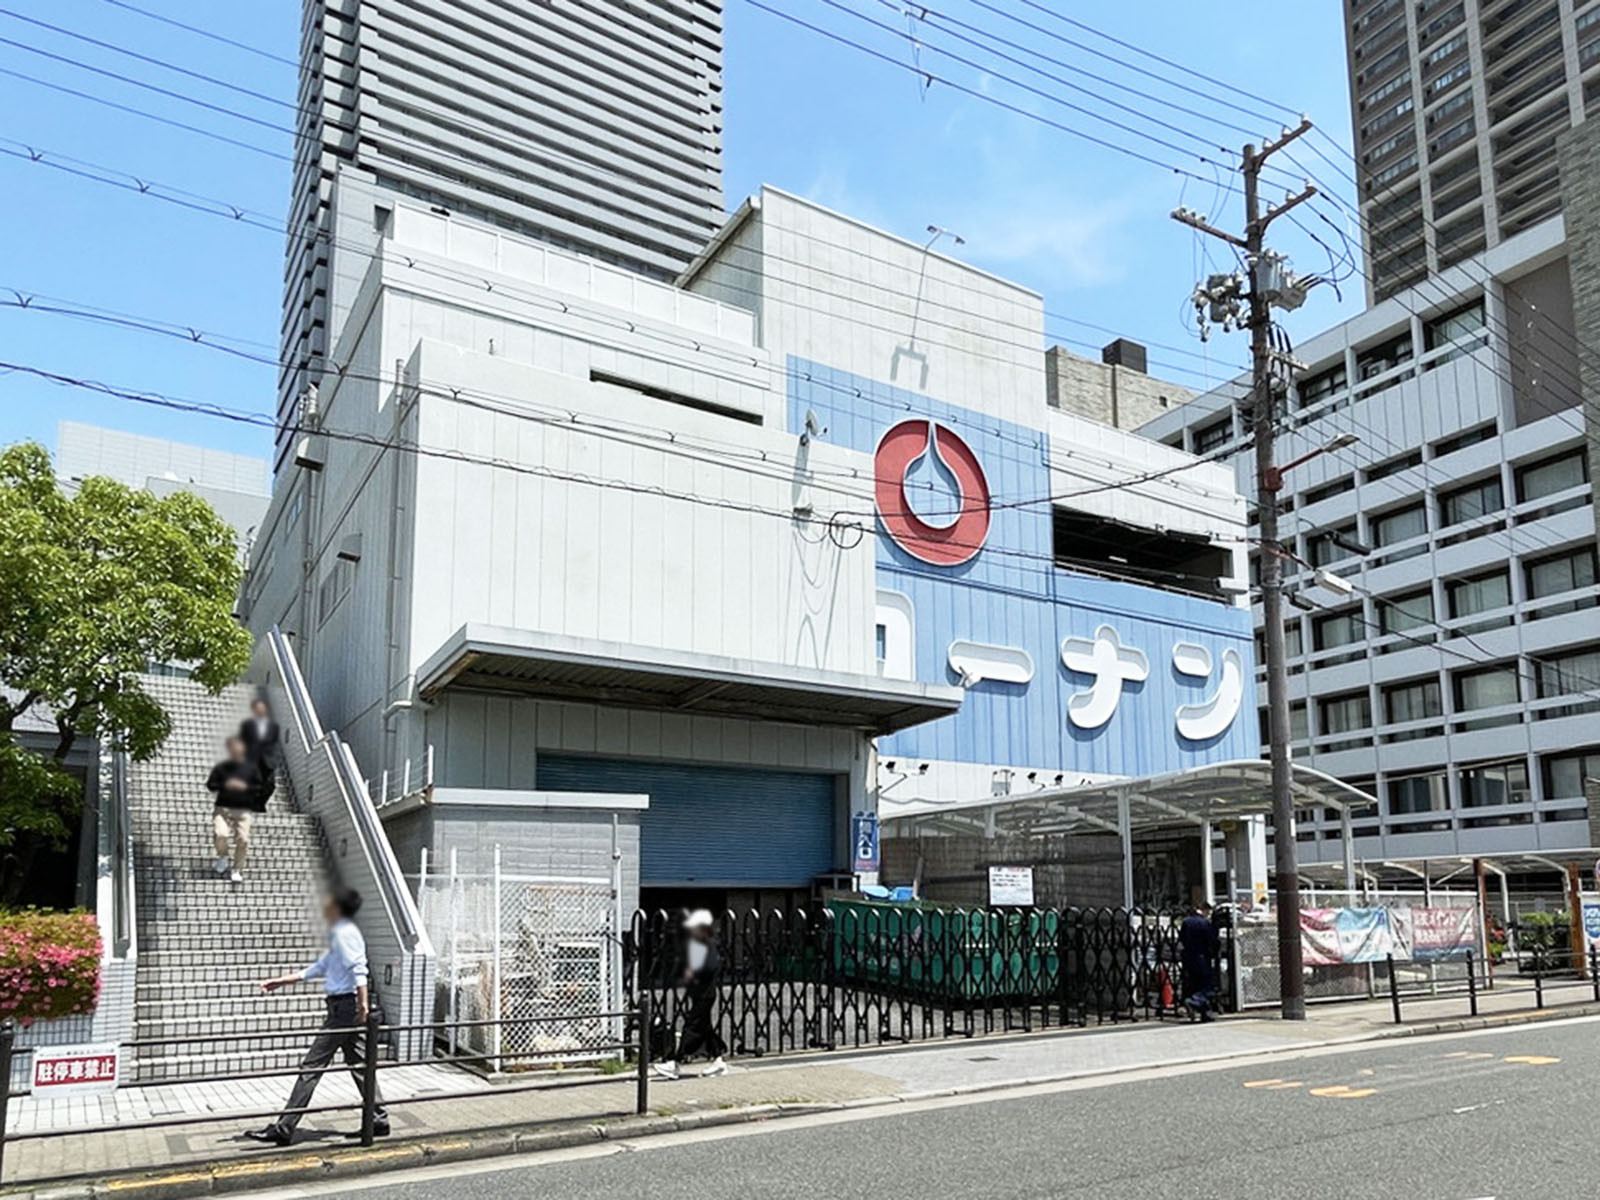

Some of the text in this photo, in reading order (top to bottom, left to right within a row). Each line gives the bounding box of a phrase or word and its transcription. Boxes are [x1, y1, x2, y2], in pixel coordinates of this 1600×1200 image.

[37, 1058, 114, 1083] 駐停車禁止
